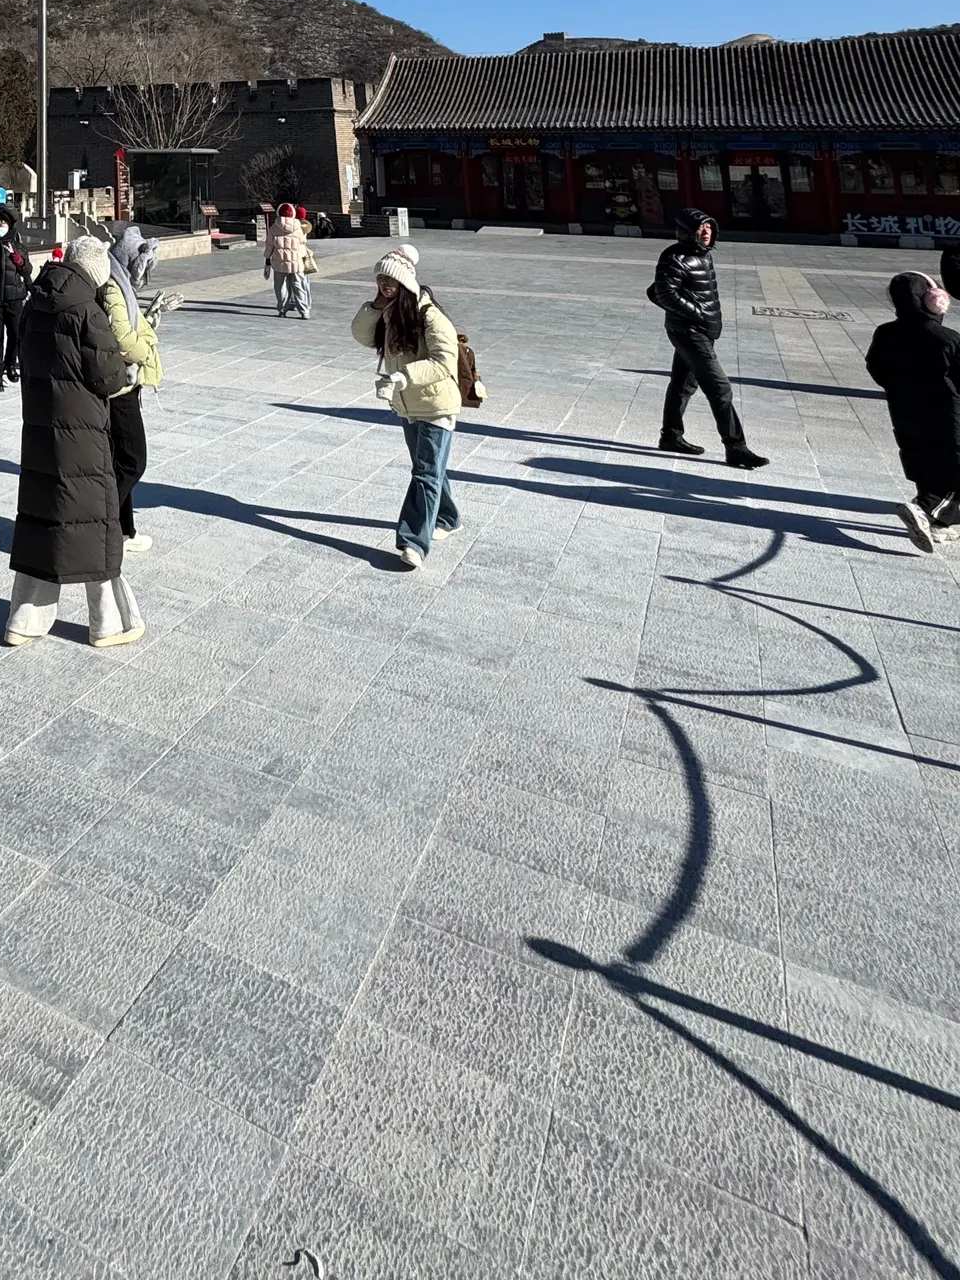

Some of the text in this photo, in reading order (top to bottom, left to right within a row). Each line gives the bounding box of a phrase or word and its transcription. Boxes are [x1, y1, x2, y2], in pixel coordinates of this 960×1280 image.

[487, 138, 540, 146] 长城礼物
[842, 213, 960, 235] 长城礼物
